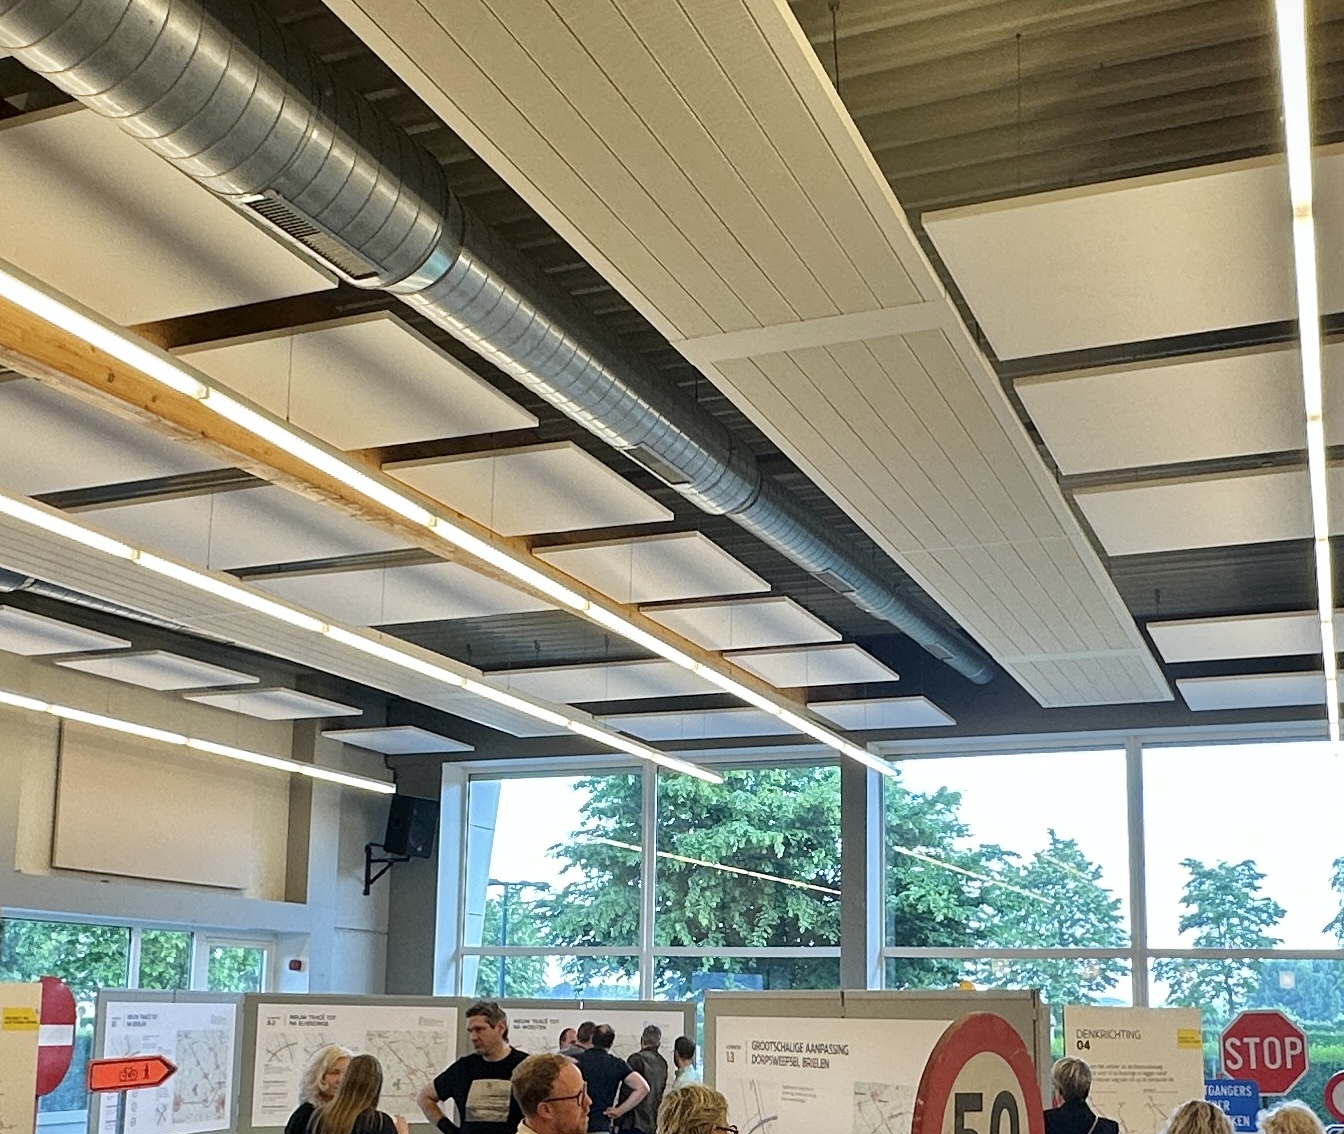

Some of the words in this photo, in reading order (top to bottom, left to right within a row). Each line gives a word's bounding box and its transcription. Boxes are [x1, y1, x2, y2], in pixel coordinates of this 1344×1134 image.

[1076, 1029, 1141, 1040] DENKRICHTING
[805, 1043, 849, 1056] AANPASSING
[1076, 1040, 1090, 1050] 04
[1224, 1036, 1303, 1070] STOP
